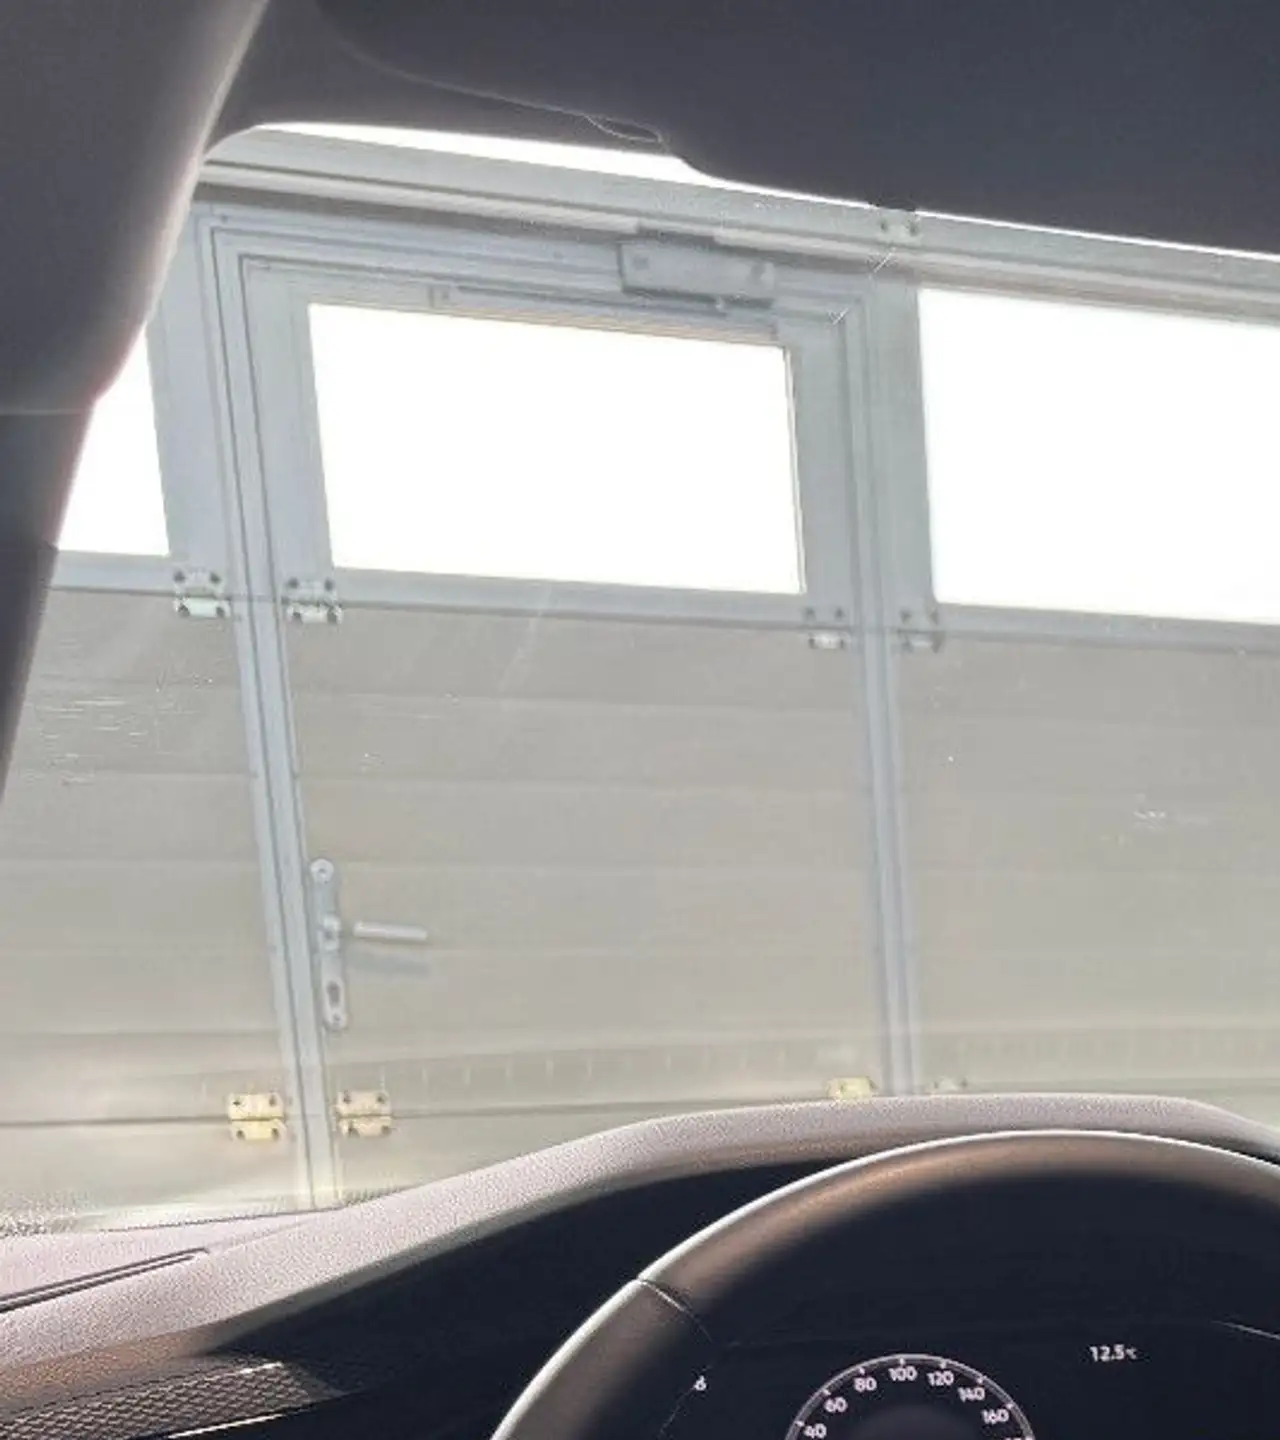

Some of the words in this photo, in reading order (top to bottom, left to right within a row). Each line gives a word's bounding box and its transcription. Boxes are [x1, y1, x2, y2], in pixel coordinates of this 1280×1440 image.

[888, 1366, 918, 1382] 100
[926, 1370, 955, 1387] 120
[854, 1376, 877, 1392] 80
[957, 1386, 986, 1403] 140
[823, 1396, 848, 1414] 60
[980, 1408, 1010, 1425] 160
[803, 1423, 828, 1440] 40
